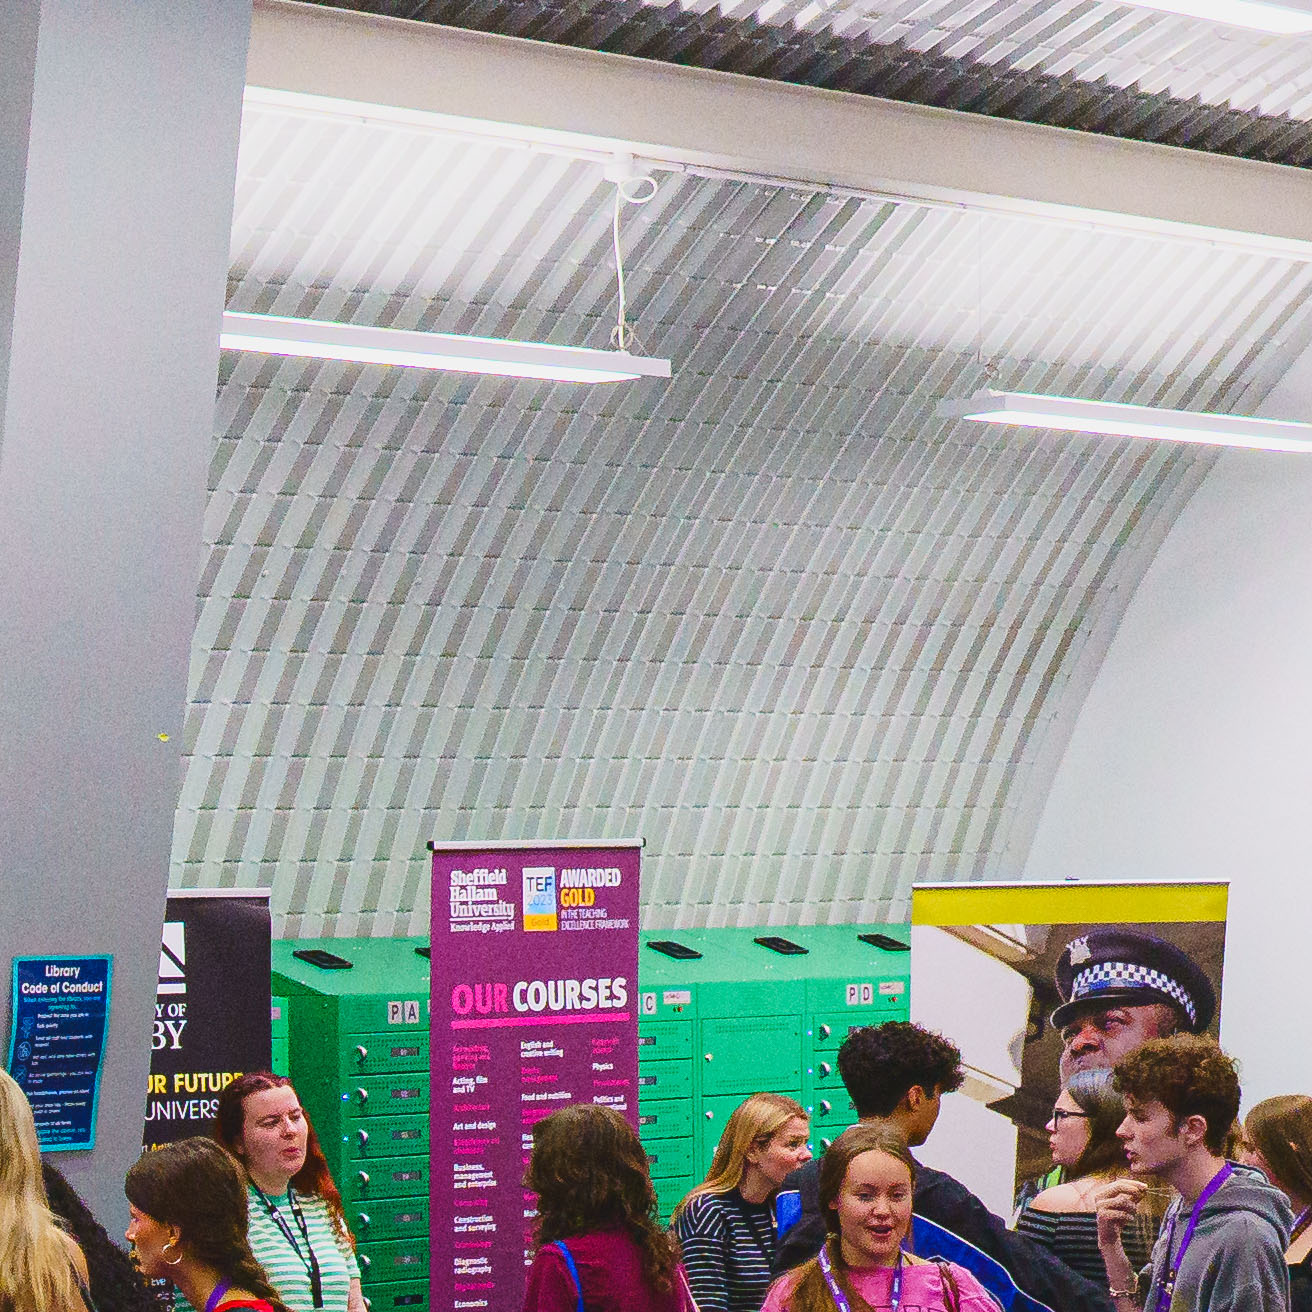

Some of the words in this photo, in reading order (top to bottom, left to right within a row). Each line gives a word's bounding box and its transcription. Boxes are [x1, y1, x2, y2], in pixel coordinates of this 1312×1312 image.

[450, 869, 507, 886] Sheffield
[526, 877, 552, 892] TEF
[560, 868, 621, 887] AWARDED
[450, 886, 498, 901] Hallam
[561, 888, 595, 907] GOLD
[450, 901, 514, 919] University
[45, 965, 81, 978] Library
[22, 983, 48, 994] Code
[50, 981, 60, 993] of
[62, 981, 103, 993] Conduct
[850, 987, 856, 1000] P
[863, 987, 869, 1000] D
[452, 983, 508, 1015] OUR
[513, 977, 627, 1012] COURSES
[646, 996, 653, 1010] C
[170, 1003, 187, 1016] OF
[392, 1004, 398, 1020] P
[408, 1004, 416, 1020] A
[175, 1073, 244, 1093] FUTUR
[145, 1100, 219, 1121] UNIVERS
